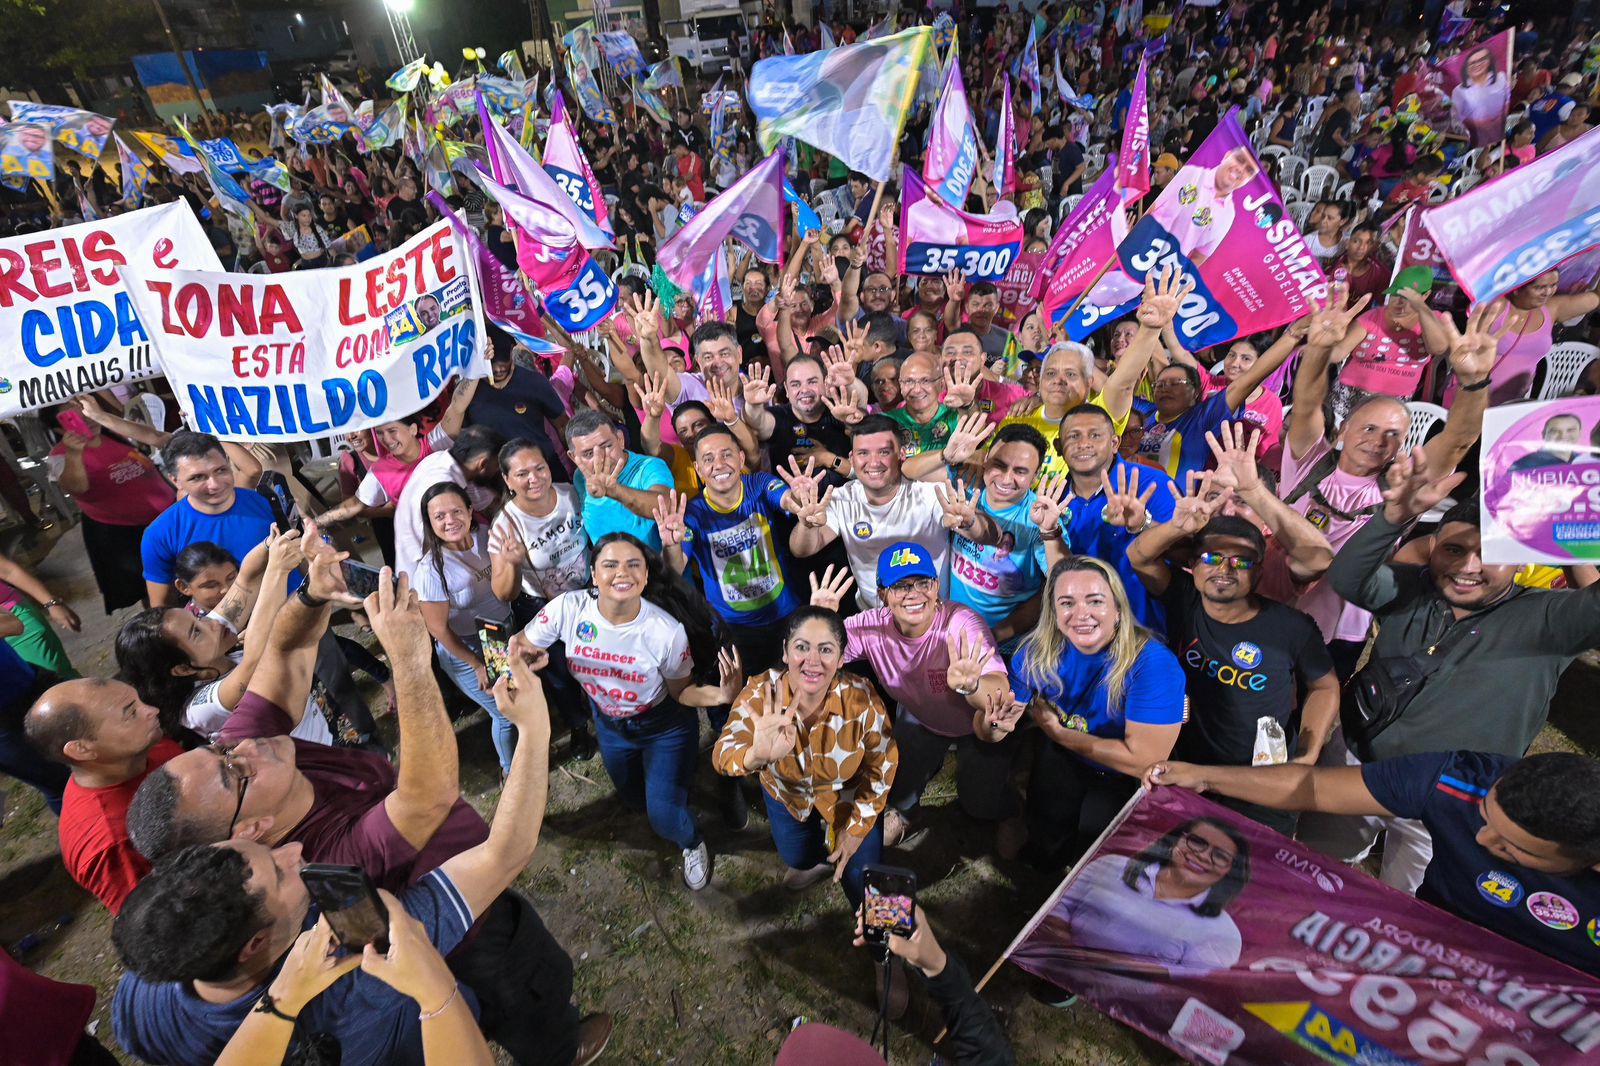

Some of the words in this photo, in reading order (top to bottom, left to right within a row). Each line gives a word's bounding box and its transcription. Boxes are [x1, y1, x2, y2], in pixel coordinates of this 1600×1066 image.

[0, 231, 127, 307] REIS
[153, 237, 179, 269] e
[1059, 263, 1082, 283] DEFESA
[1081, 256, 1092, 267] DA
[1222, 270, 1235, 287] VIDA
[146, 280, 303, 339] ZONA
[339, 226, 456, 326] LESTE
[446, 280, 467, 297] Pronto
[1239, 275, 1258, 299] DEFESA
[1263, 253, 1304, 313] GADELHA
[391, 318, 414, 337] 44
[232, 336, 305, 378] ESTÁ
[336, 325, 391, 369] COM
[18, 357, 125, 409] MANAUS
[187, 369, 388, 435] NAZILDO
[412, 319, 475, 400] REIS
[530, 519, 582, 551] FAMOUS
[712, 526, 756, 549] ROBERTO
[956, 537, 981, 560] Ricardo
[573, 644, 637, 664] #Câncer
[1235, 649, 1256, 665] 44
[1481, 880, 1514, 902] 44
